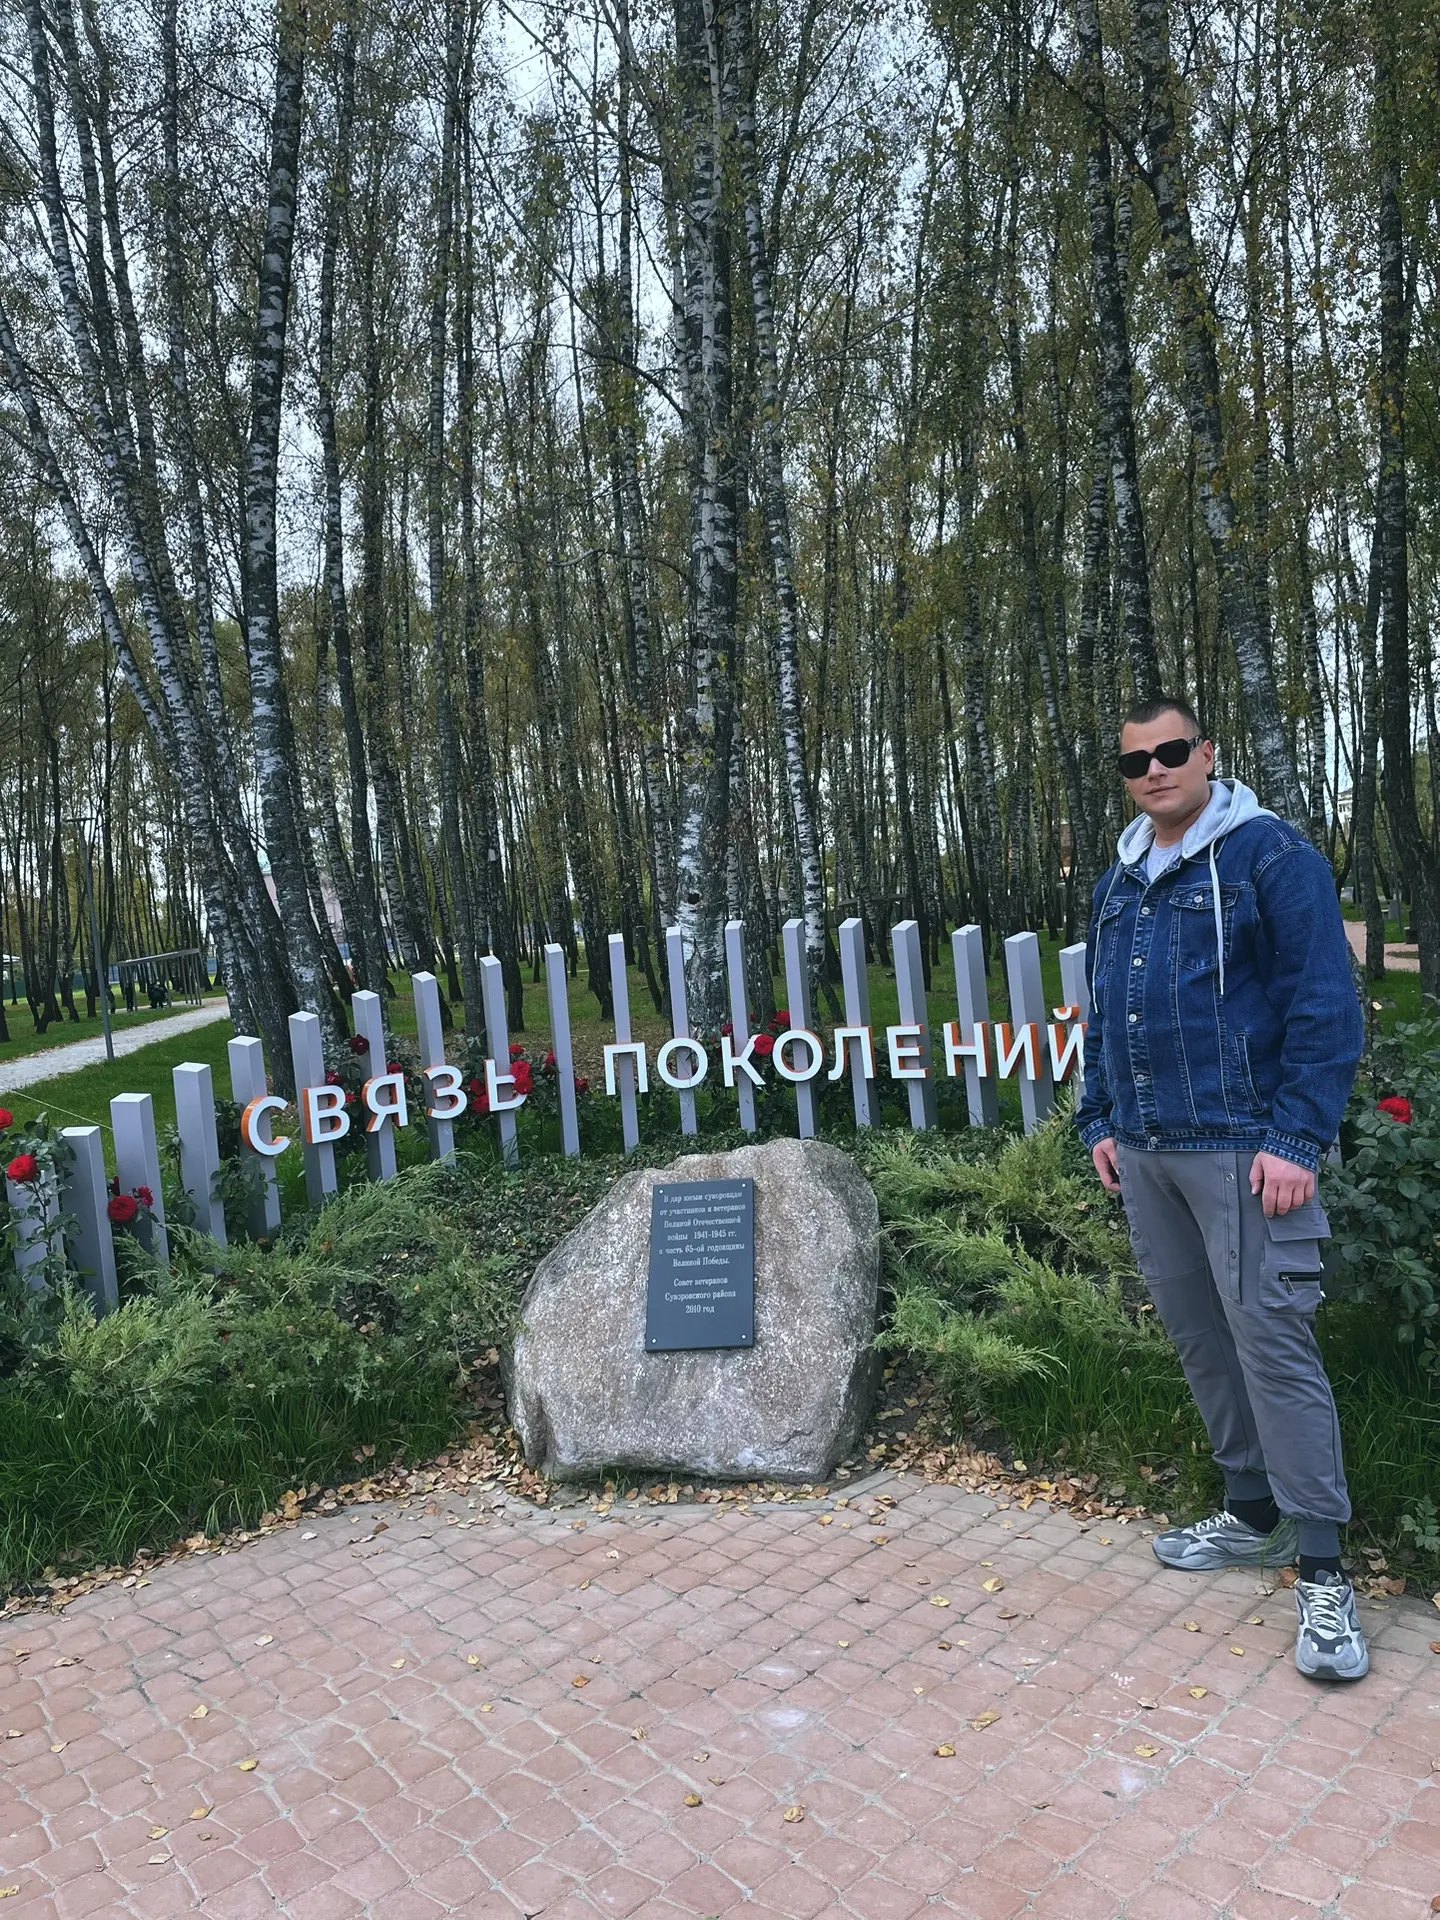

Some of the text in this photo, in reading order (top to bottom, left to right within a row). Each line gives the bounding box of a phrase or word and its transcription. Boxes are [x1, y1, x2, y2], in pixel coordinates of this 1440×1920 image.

[241, 1006, 1086, 1156] СВЯЗЬ ПОКОЛЕНИЙ
[670, 1195, 682, 1203] дар
[684, 1193, 702, 1202] юным
[704, 1191, 742, 1201] суворовцам
[668, 1206, 706, 1216] участников
[713, 1204, 746, 1213] ветеранов
[664, 1216, 742, 1228] Великой Отечественной
[667, 1232, 688, 1241] войны
[694, 1229, 727, 1240] 1941-1945
[665, 1246, 683, 1255] честь
[685, 1244, 705, 1253] 65-ой
[707, 1242, 745, 1252] годовщины
[673, 1257, 701, 1267] Великой
[673, 1277, 728, 1287] Совет ветеранов
[664, 1289, 736, 1302] Суворовского района
[685, 1304, 715, 1314] 2010 год
